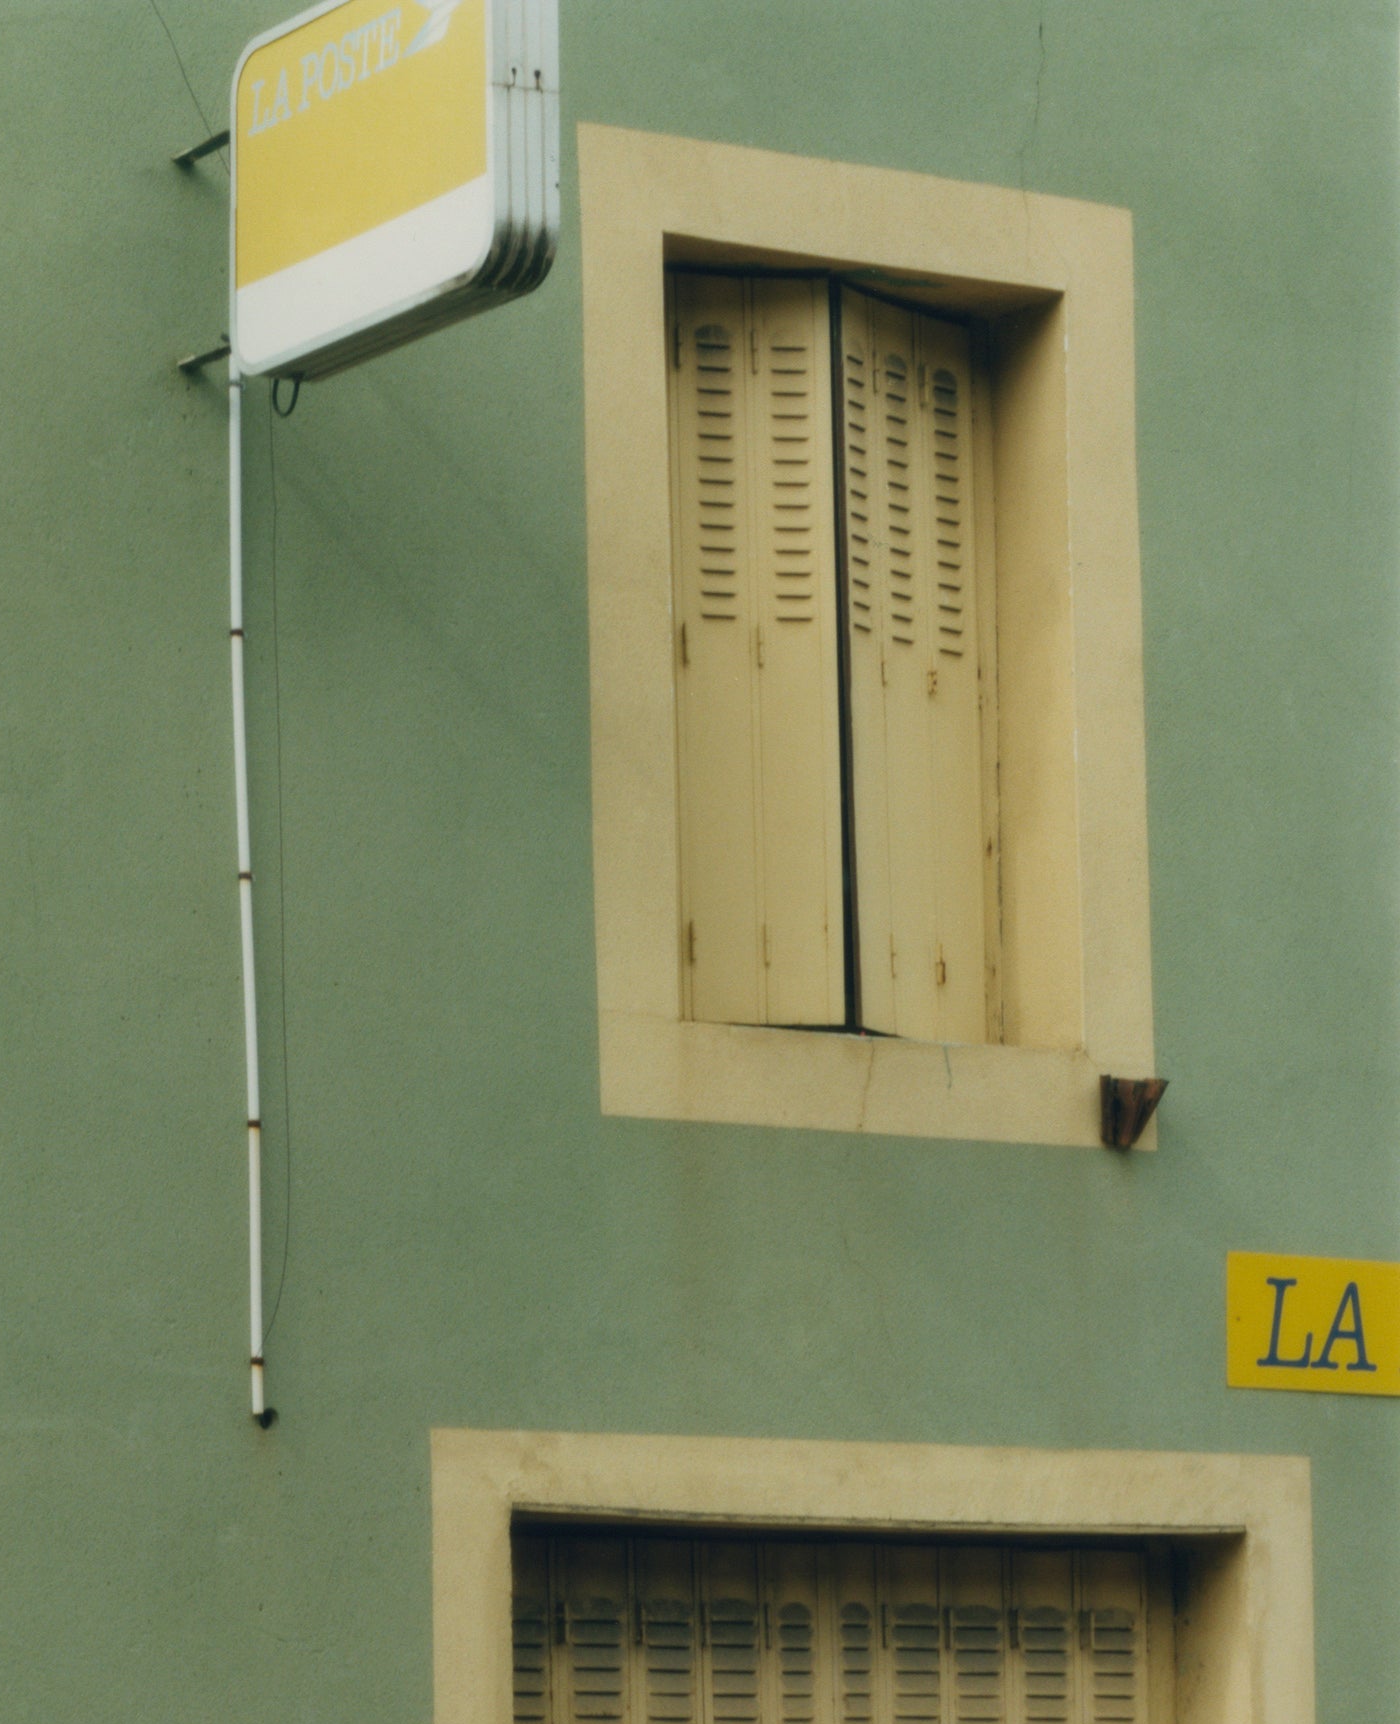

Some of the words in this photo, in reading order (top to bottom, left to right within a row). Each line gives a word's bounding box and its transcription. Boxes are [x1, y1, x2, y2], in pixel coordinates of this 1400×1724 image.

[248, 68, 293, 136] LA
[298, 9, 401, 112] POSTE
[1257, 1277, 1377, 1372] LA
